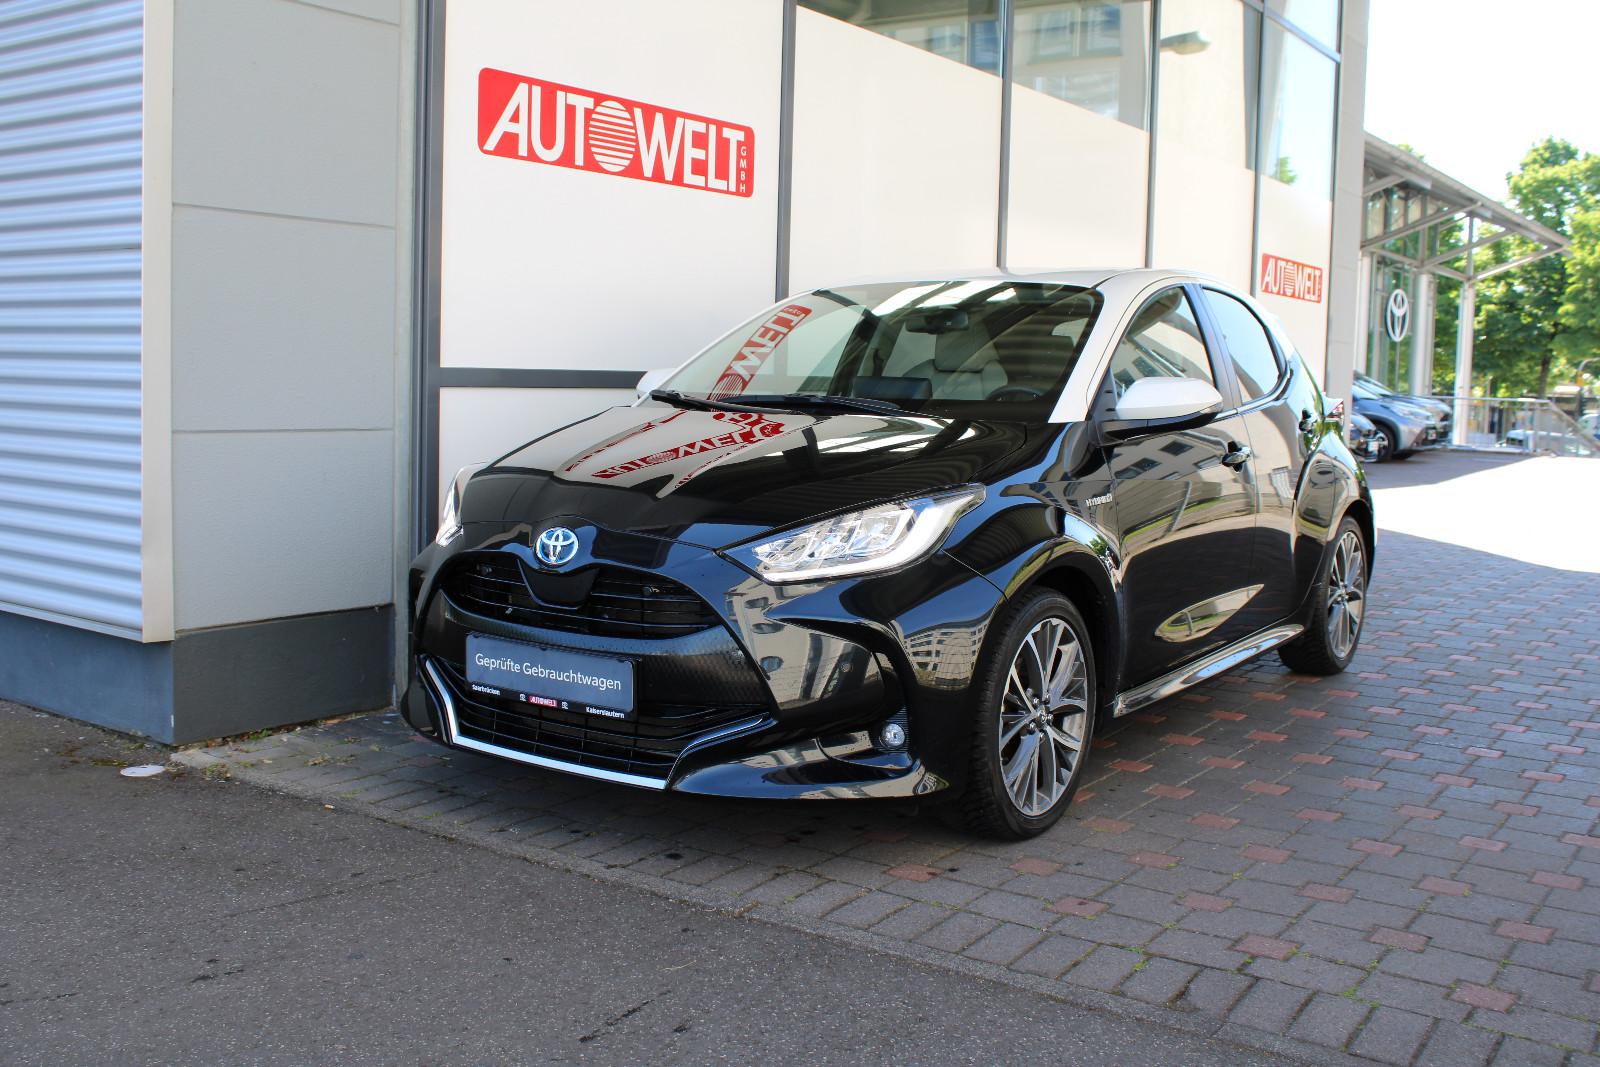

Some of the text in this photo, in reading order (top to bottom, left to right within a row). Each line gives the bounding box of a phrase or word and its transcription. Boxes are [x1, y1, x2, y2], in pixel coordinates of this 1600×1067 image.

[483, 82, 744, 192] AUTOWELT
[1262, 257, 1319, 300] AUTOWELT
[475, 653, 621, 690] Geprüfte Gebrauchtwagen
[586, 706, 625, 719] Kaiserslautern
